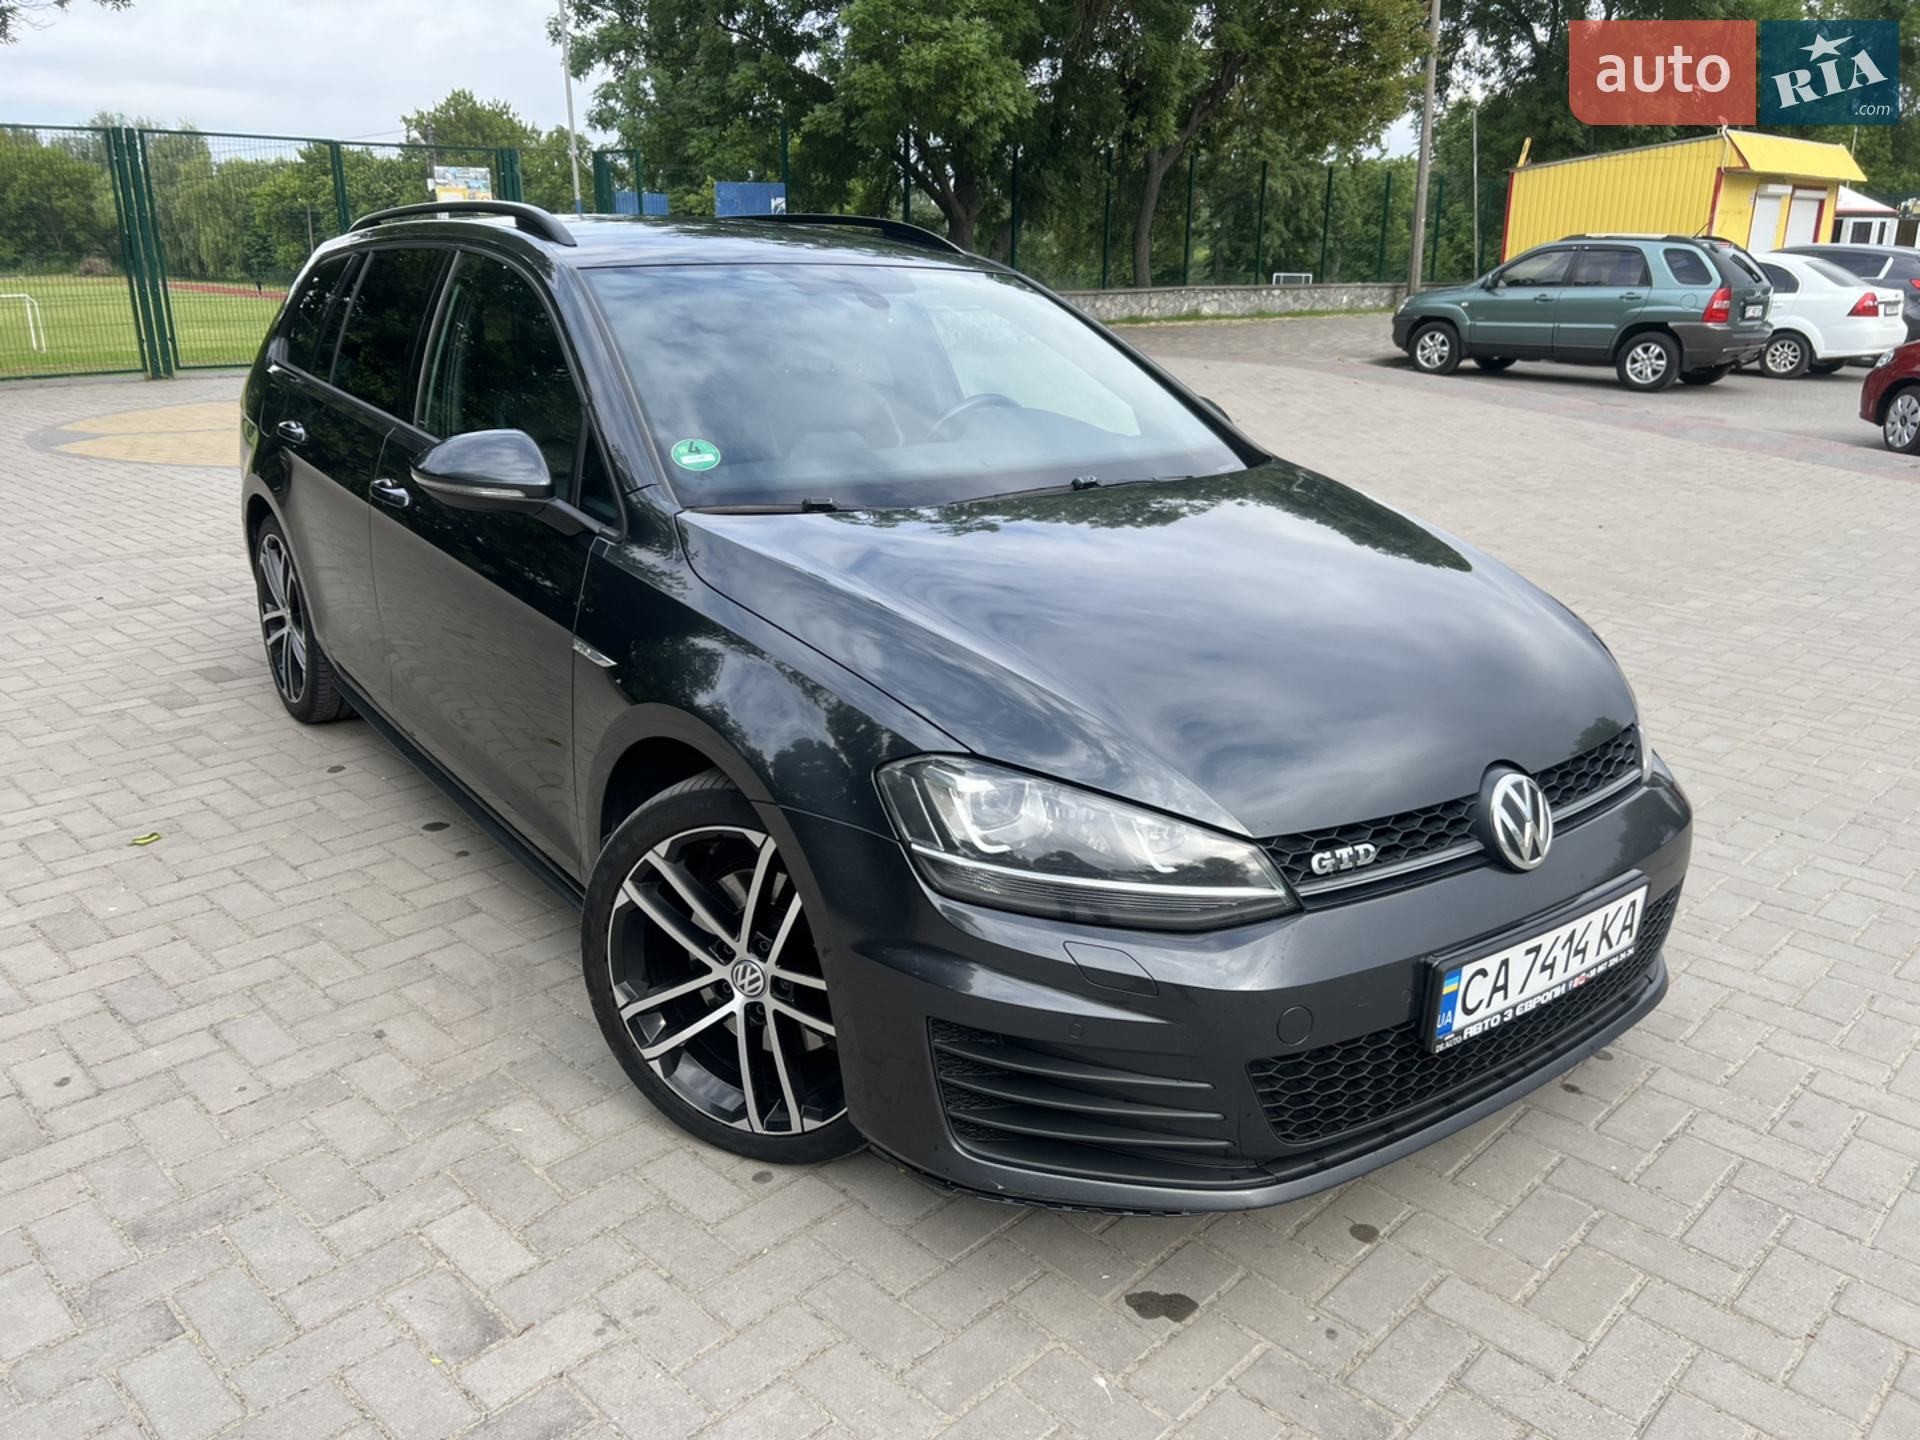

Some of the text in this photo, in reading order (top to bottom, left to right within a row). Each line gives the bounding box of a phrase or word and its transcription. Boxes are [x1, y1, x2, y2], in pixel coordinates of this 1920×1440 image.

[687, 441, 702, 455] 4
[1311, 843, 1376, 875] GTD
[1460, 898, 1638, 1016] CA 7414 KA
[1436, 1010, 1453, 1029] UA
[1463, 1014, 1501, 1040] АВТО
